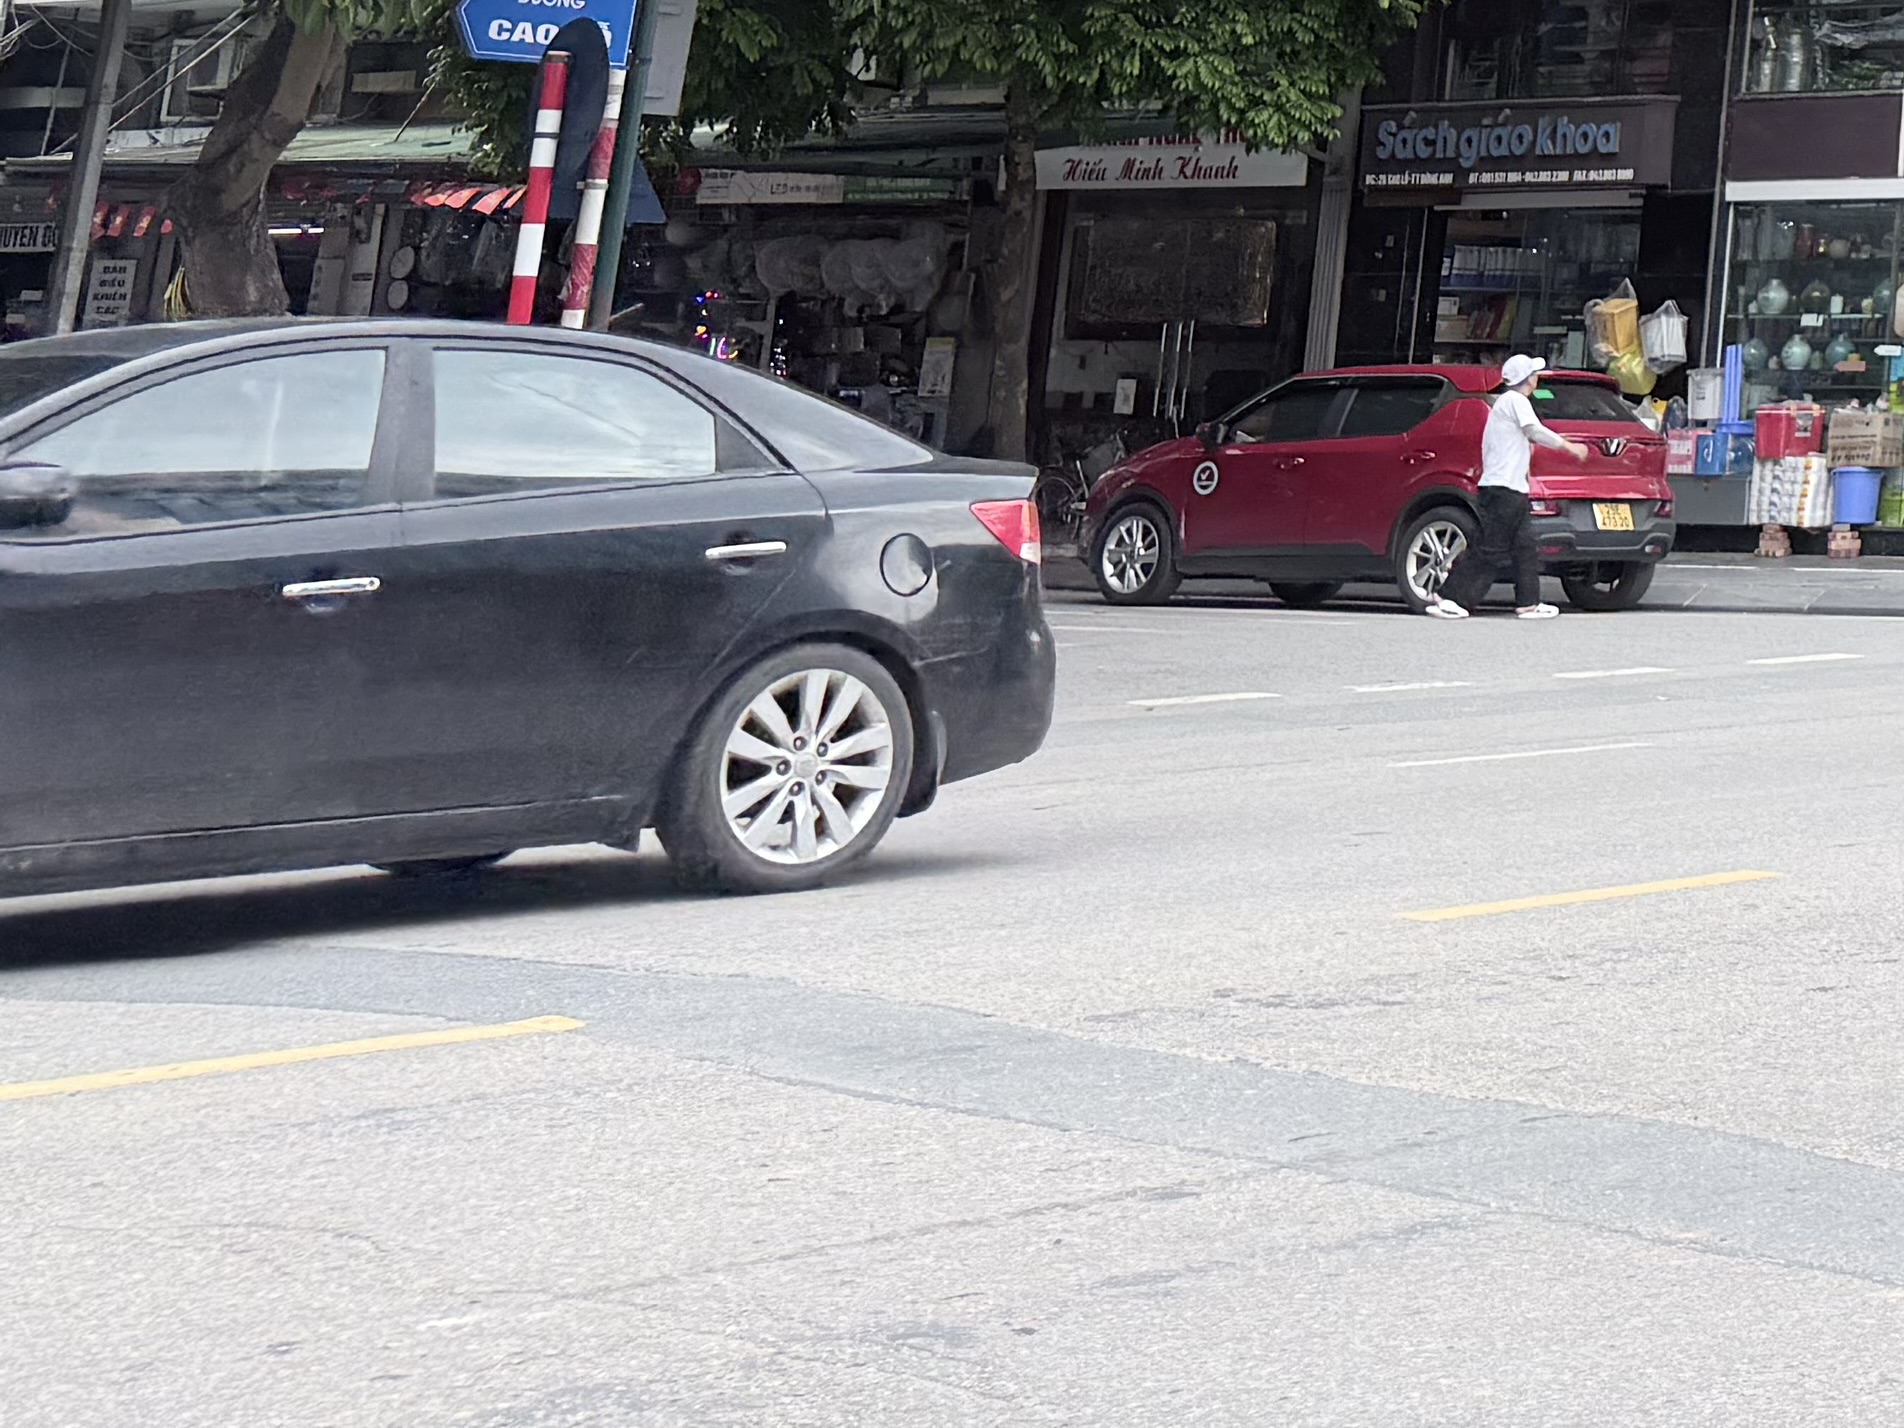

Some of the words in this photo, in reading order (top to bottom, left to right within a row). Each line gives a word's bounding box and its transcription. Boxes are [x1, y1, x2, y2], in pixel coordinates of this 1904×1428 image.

[488, 18, 560, 45] CAO
[1376, 110, 1458, 159] Sách
[1459, 108, 1534, 169] giáo
[1535, 115, 1621, 156] khoa
[1115, 157, 1164, 181] Minh
[1170, 155, 1240, 180] Khanh
